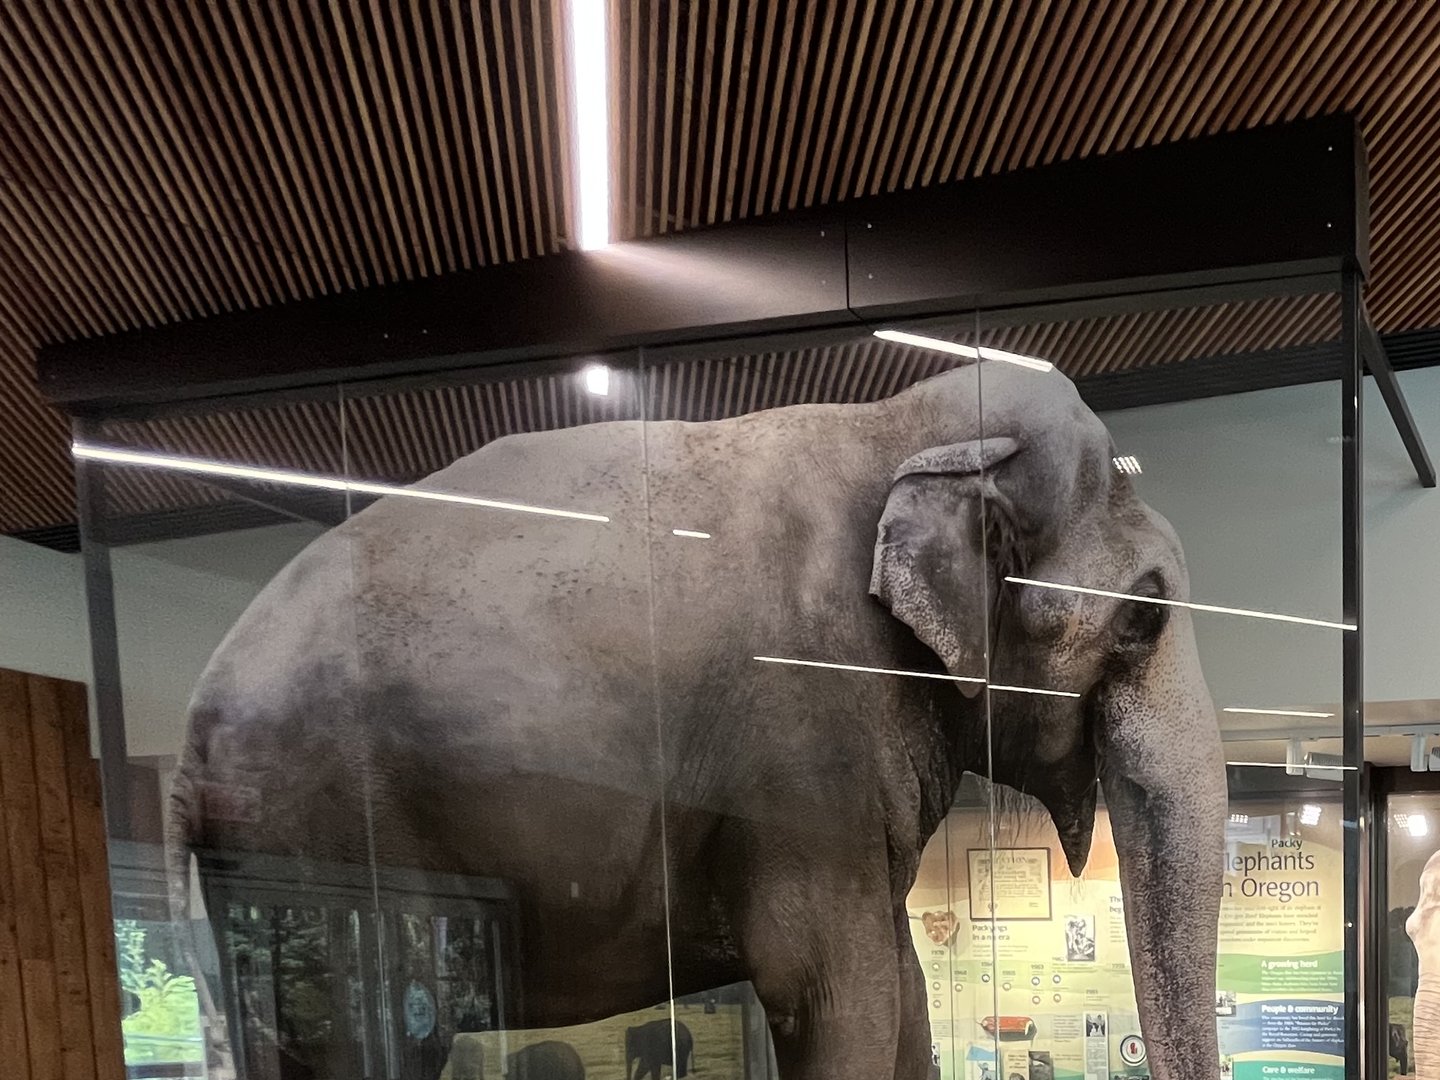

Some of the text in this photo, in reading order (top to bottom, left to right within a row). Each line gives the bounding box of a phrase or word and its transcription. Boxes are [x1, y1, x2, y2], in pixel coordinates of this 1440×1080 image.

[1271, 839, 1302, 850] Packy
[1226, 851, 1315, 877] lephants
[1241, 878, 1319, 903] Oregon
[1261, 960, 1319, 970] A growing herd
[1261, 1004, 1287, 1015] People
[1294, 1005, 1339, 1015] community
[1262, 1066, 1280, 1074] Care
[1287, 1066, 1316, 1074] welfare
